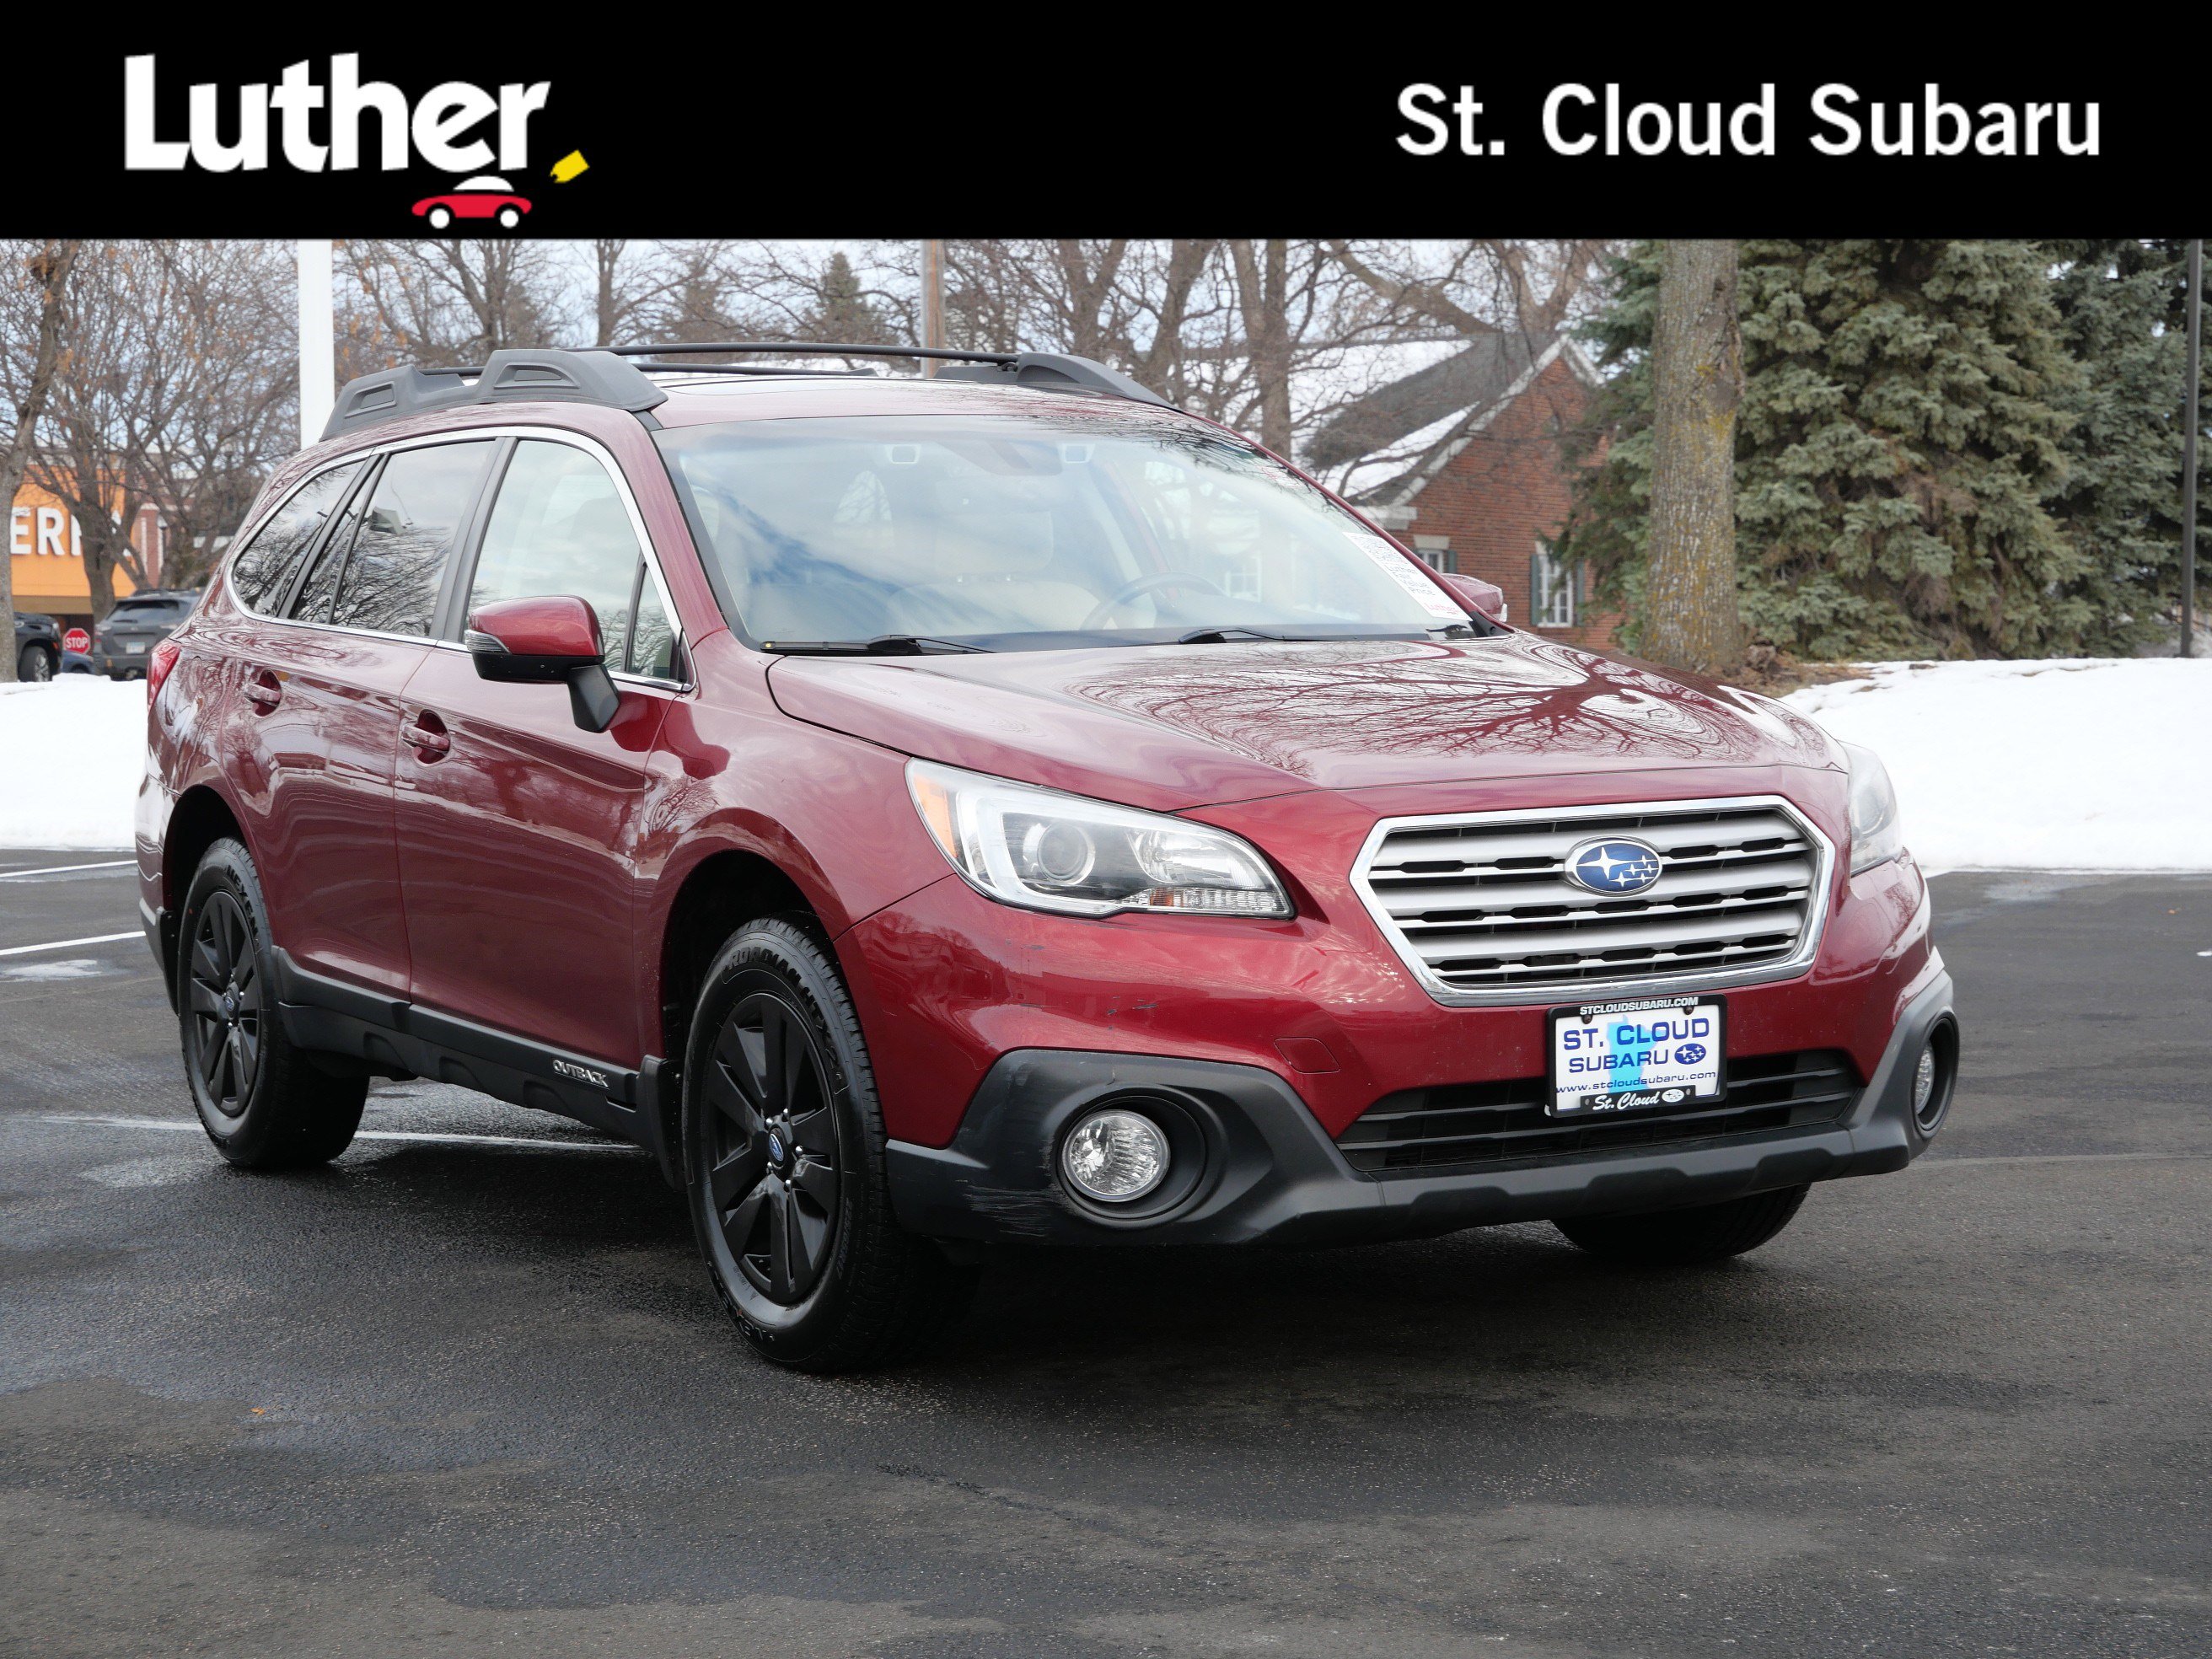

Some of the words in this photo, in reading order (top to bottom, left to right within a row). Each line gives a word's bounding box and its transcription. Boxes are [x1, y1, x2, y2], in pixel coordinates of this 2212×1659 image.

[66, 636, 88, 649] STOP
[1580, 996, 1699, 1015] STCLOUDSUBARU.COM
[1563, 1028, 1603, 1050] ST.
[1616, 1017, 1710, 1045] CLOUD
[1569, 1049, 1669, 1073] SUBARU
[552, 1060, 609, 1087] OUTBACK
[1556, 1071, 1716, 1093] www.stcloudsubaru.com
[1592, 1096, 1615, 1111] St.
[1616, 1089, 1660, 1110] Cloud
